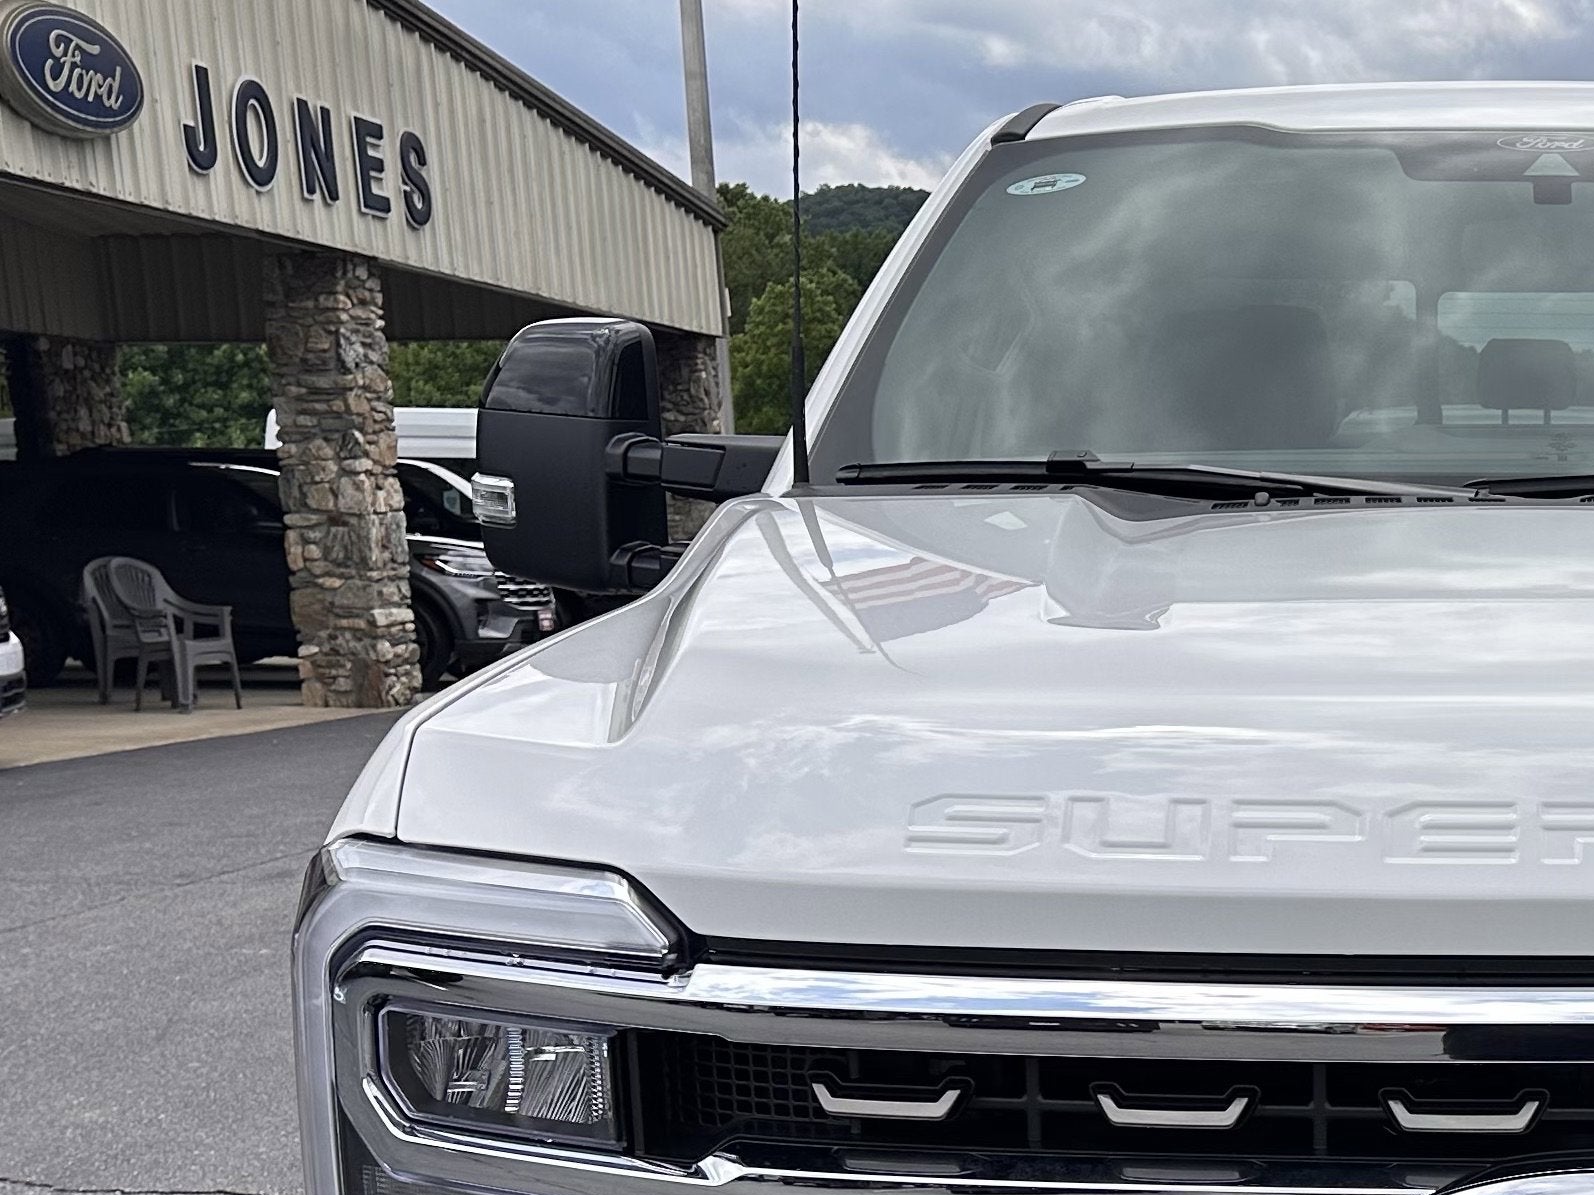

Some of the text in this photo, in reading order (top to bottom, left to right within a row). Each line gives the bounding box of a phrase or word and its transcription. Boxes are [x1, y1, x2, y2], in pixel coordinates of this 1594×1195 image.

[44, 29, 123, 110] Ford
[182, 60, 432, 230] JONES
[1516, 135, 1585, 149] Ford
